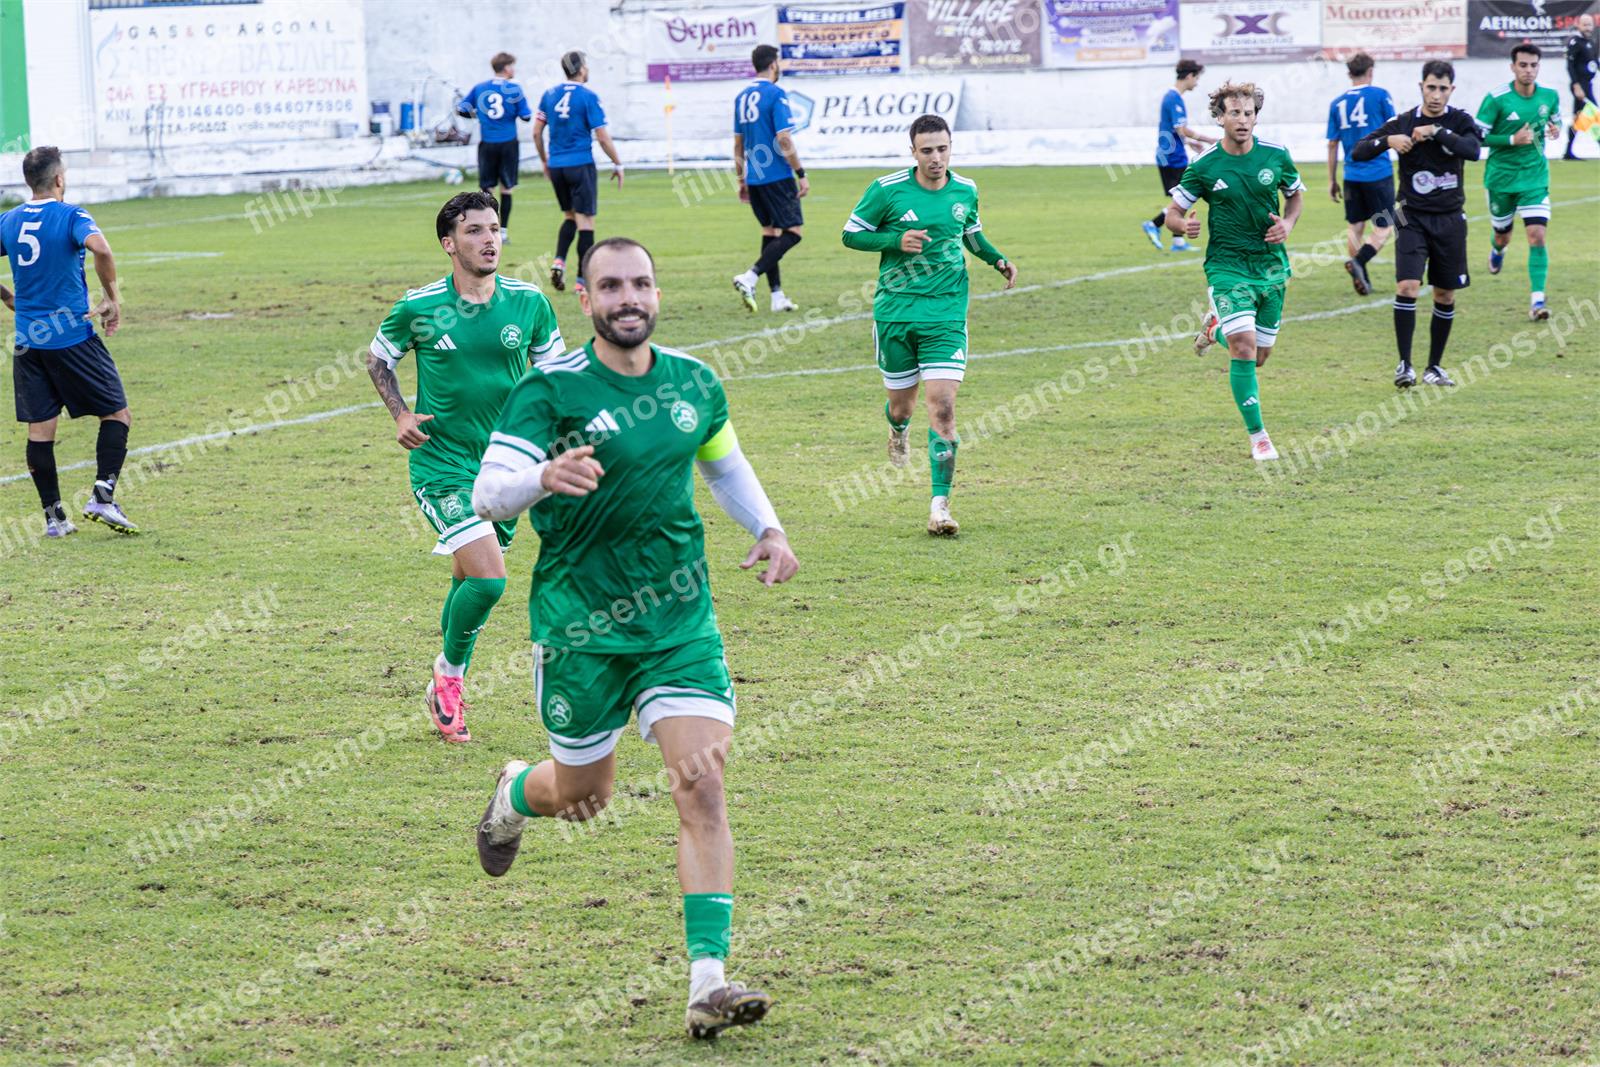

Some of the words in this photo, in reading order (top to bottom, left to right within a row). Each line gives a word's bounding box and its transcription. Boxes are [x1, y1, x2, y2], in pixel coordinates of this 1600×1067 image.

[926, 0, 1018, 22] VILLAGE
[1479, 15, 1552, 30] AETHLON
[487, 93, 505, 120] 3
[554, 91, 570, 119] 4
[738, 90, 760, 124] 18
[821, 91, 955, 118] PIAGGIO
[1336, 97, 1369, 130] 14
[17, 221, 42, 267] 5
